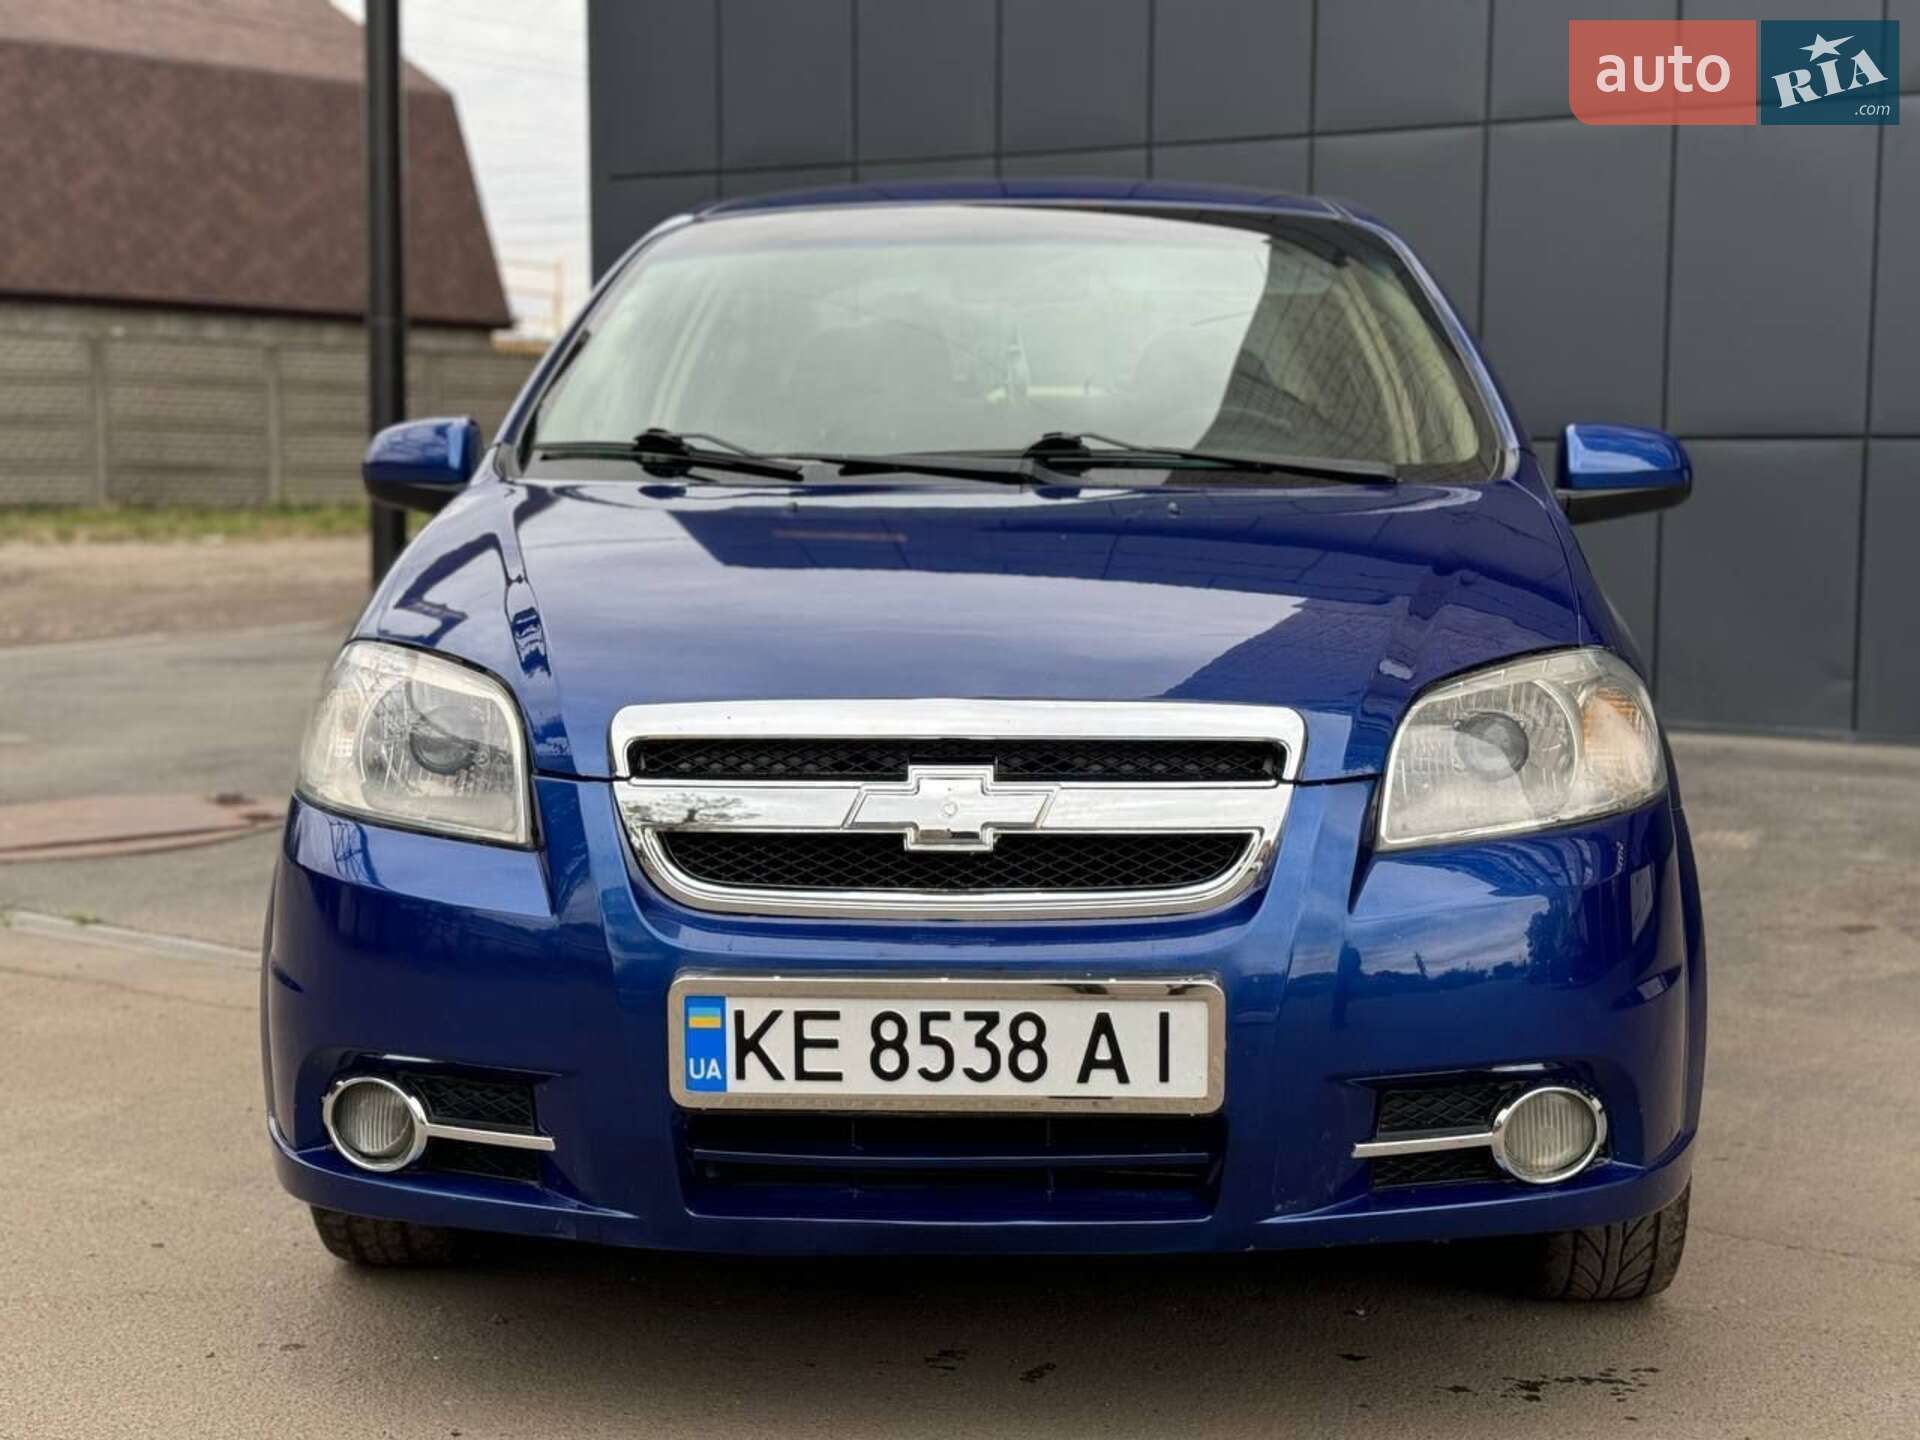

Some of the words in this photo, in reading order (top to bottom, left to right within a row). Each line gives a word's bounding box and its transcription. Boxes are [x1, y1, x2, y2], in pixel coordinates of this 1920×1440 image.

[689, 1055, 722, 1080] UA
[734, 1008, 843, 1082] KE
[869, 1010, 1048, 1084] 8538
